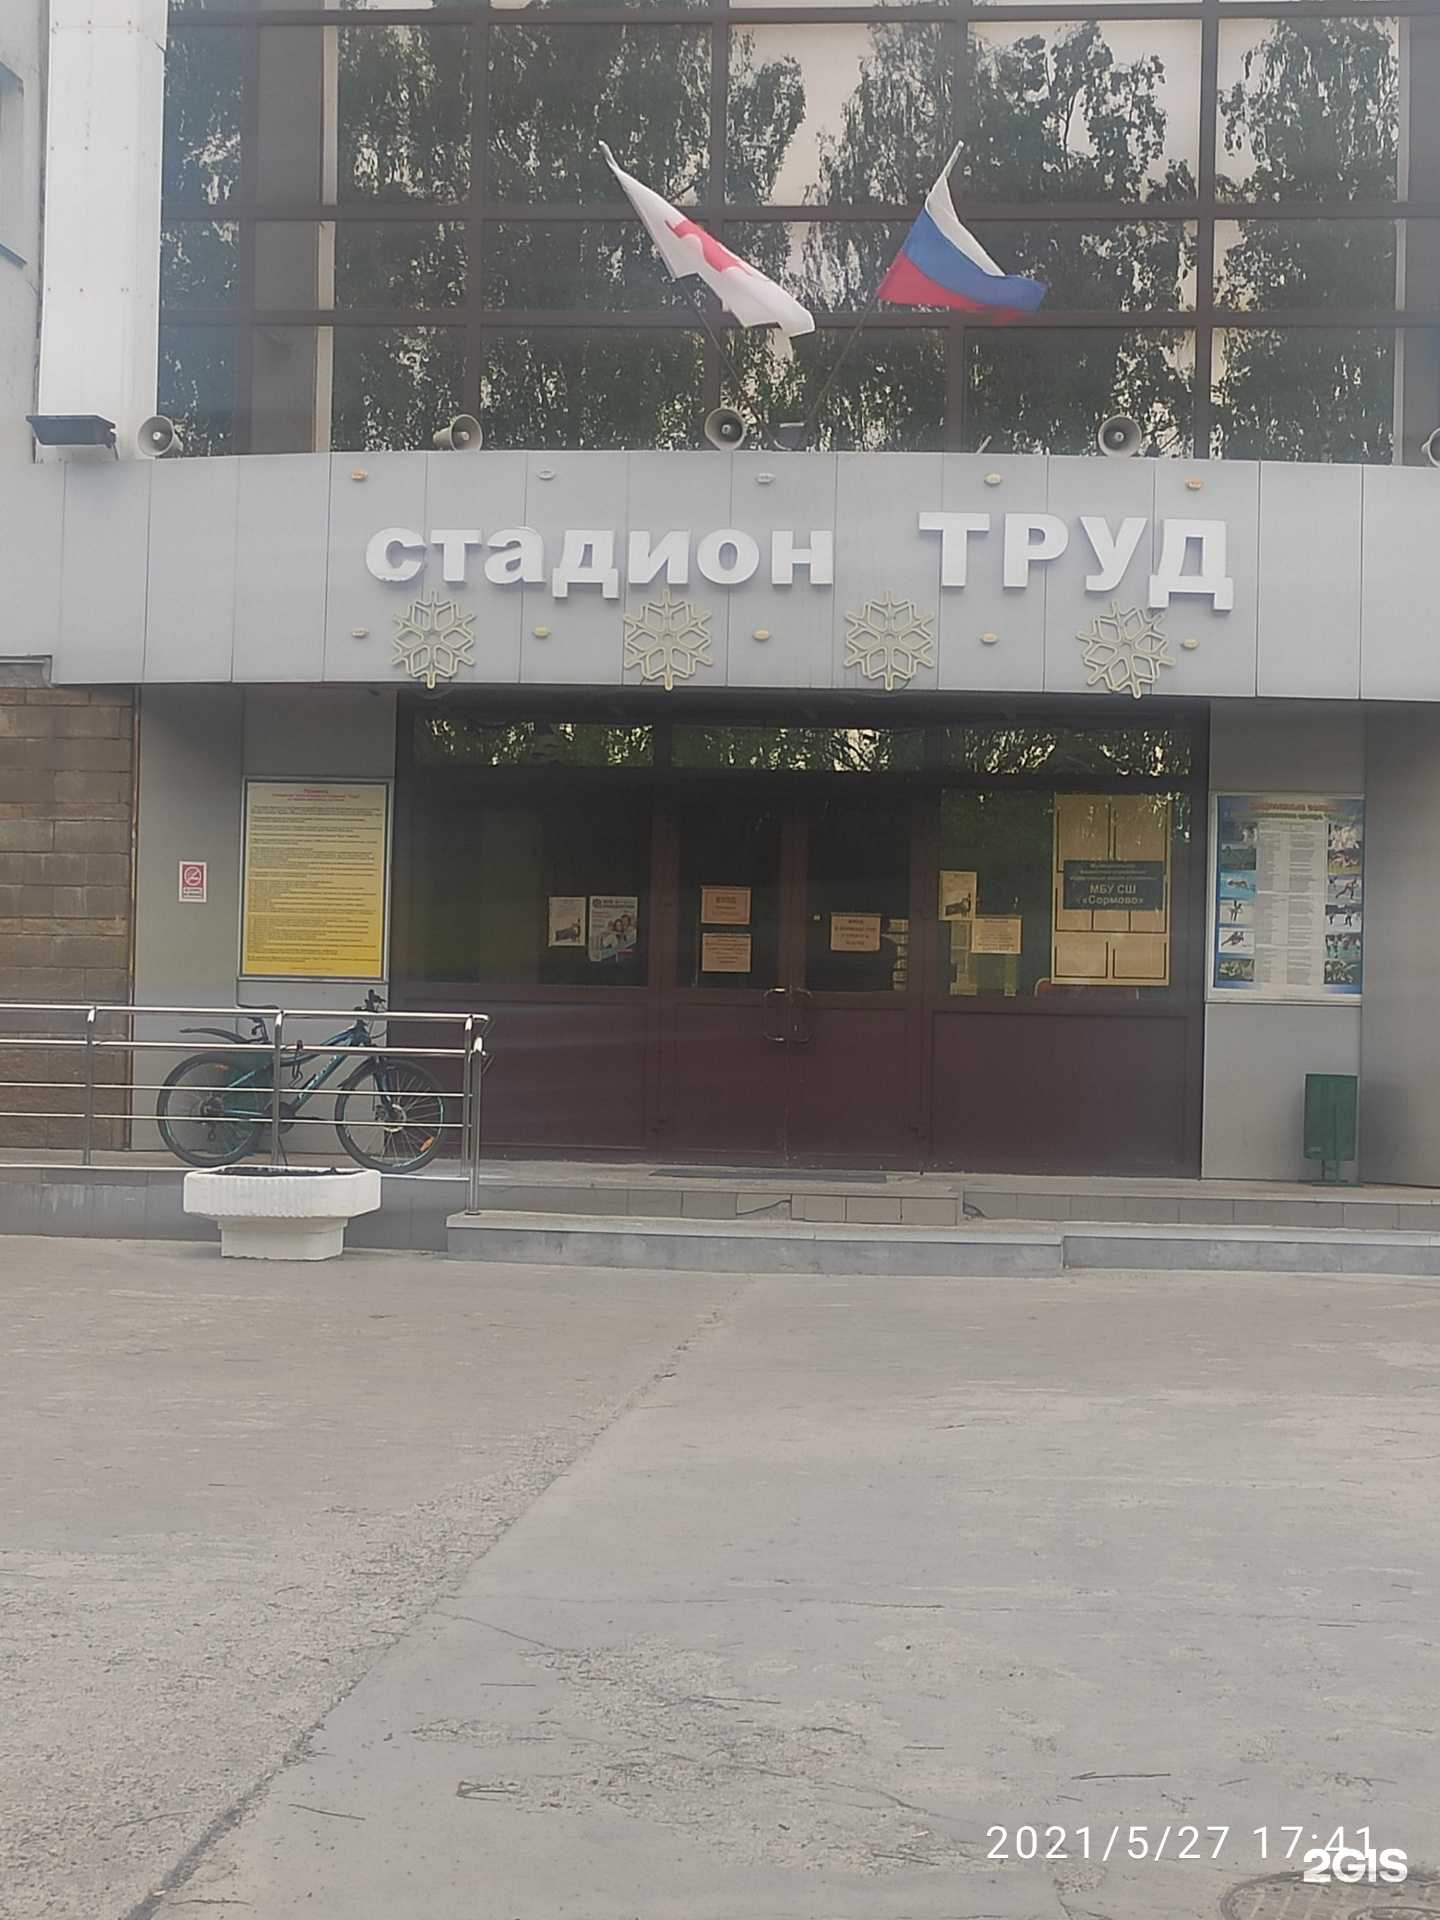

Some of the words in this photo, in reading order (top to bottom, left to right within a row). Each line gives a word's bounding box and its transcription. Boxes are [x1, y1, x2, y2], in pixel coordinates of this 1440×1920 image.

[366, 524, 835, 600] стадион
[918, 511, 1235, 612] ТРУД
[1089, 883, 1114, 894] МБУ
[1117, 883, 1137, 894] СШ
